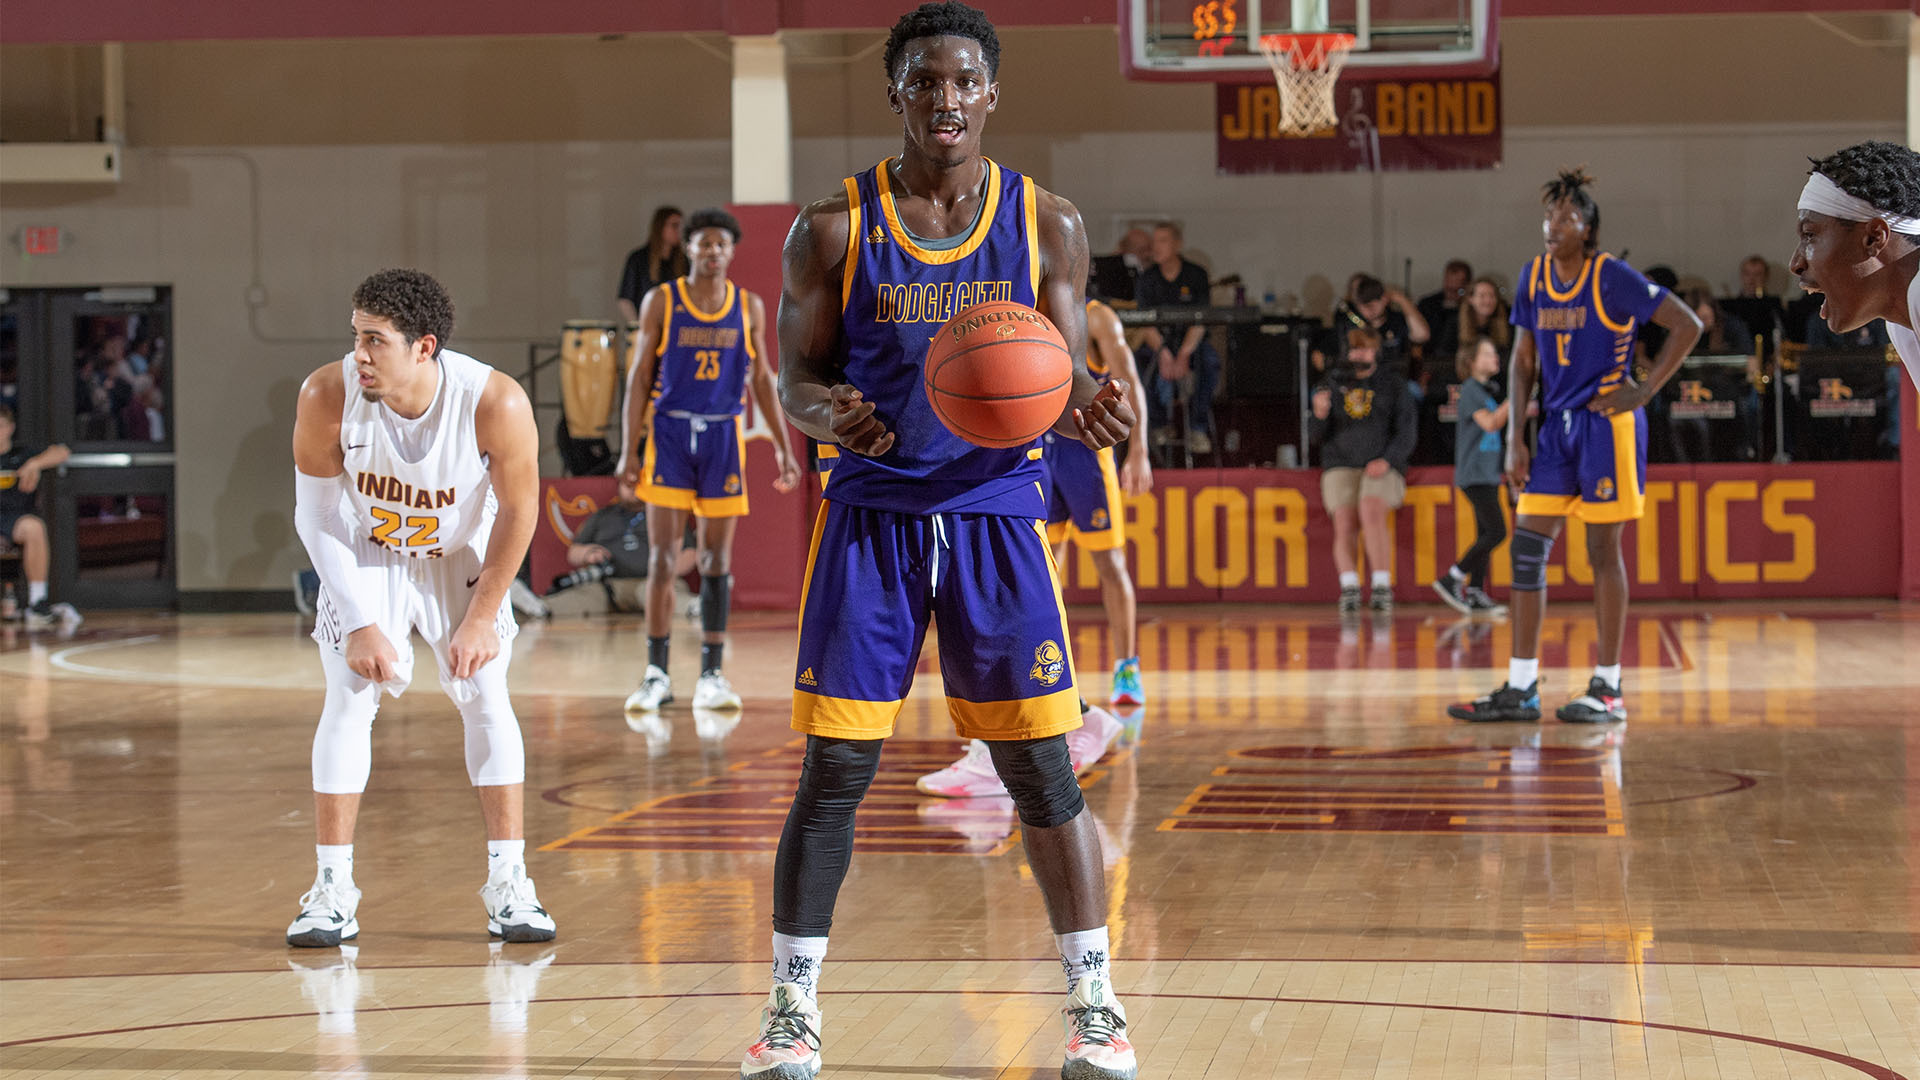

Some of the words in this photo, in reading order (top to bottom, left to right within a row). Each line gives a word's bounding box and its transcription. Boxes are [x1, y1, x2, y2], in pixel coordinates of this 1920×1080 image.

[1222, 87, 1336, 139] JA
[1377, 82, 1496, 136] BAND
[875, 281, 953, 323] DODGE
[694, 350, 720, 380] 23
[357, 471, 456, 510] INDIAN
[370, 506, 440, 548] 22
